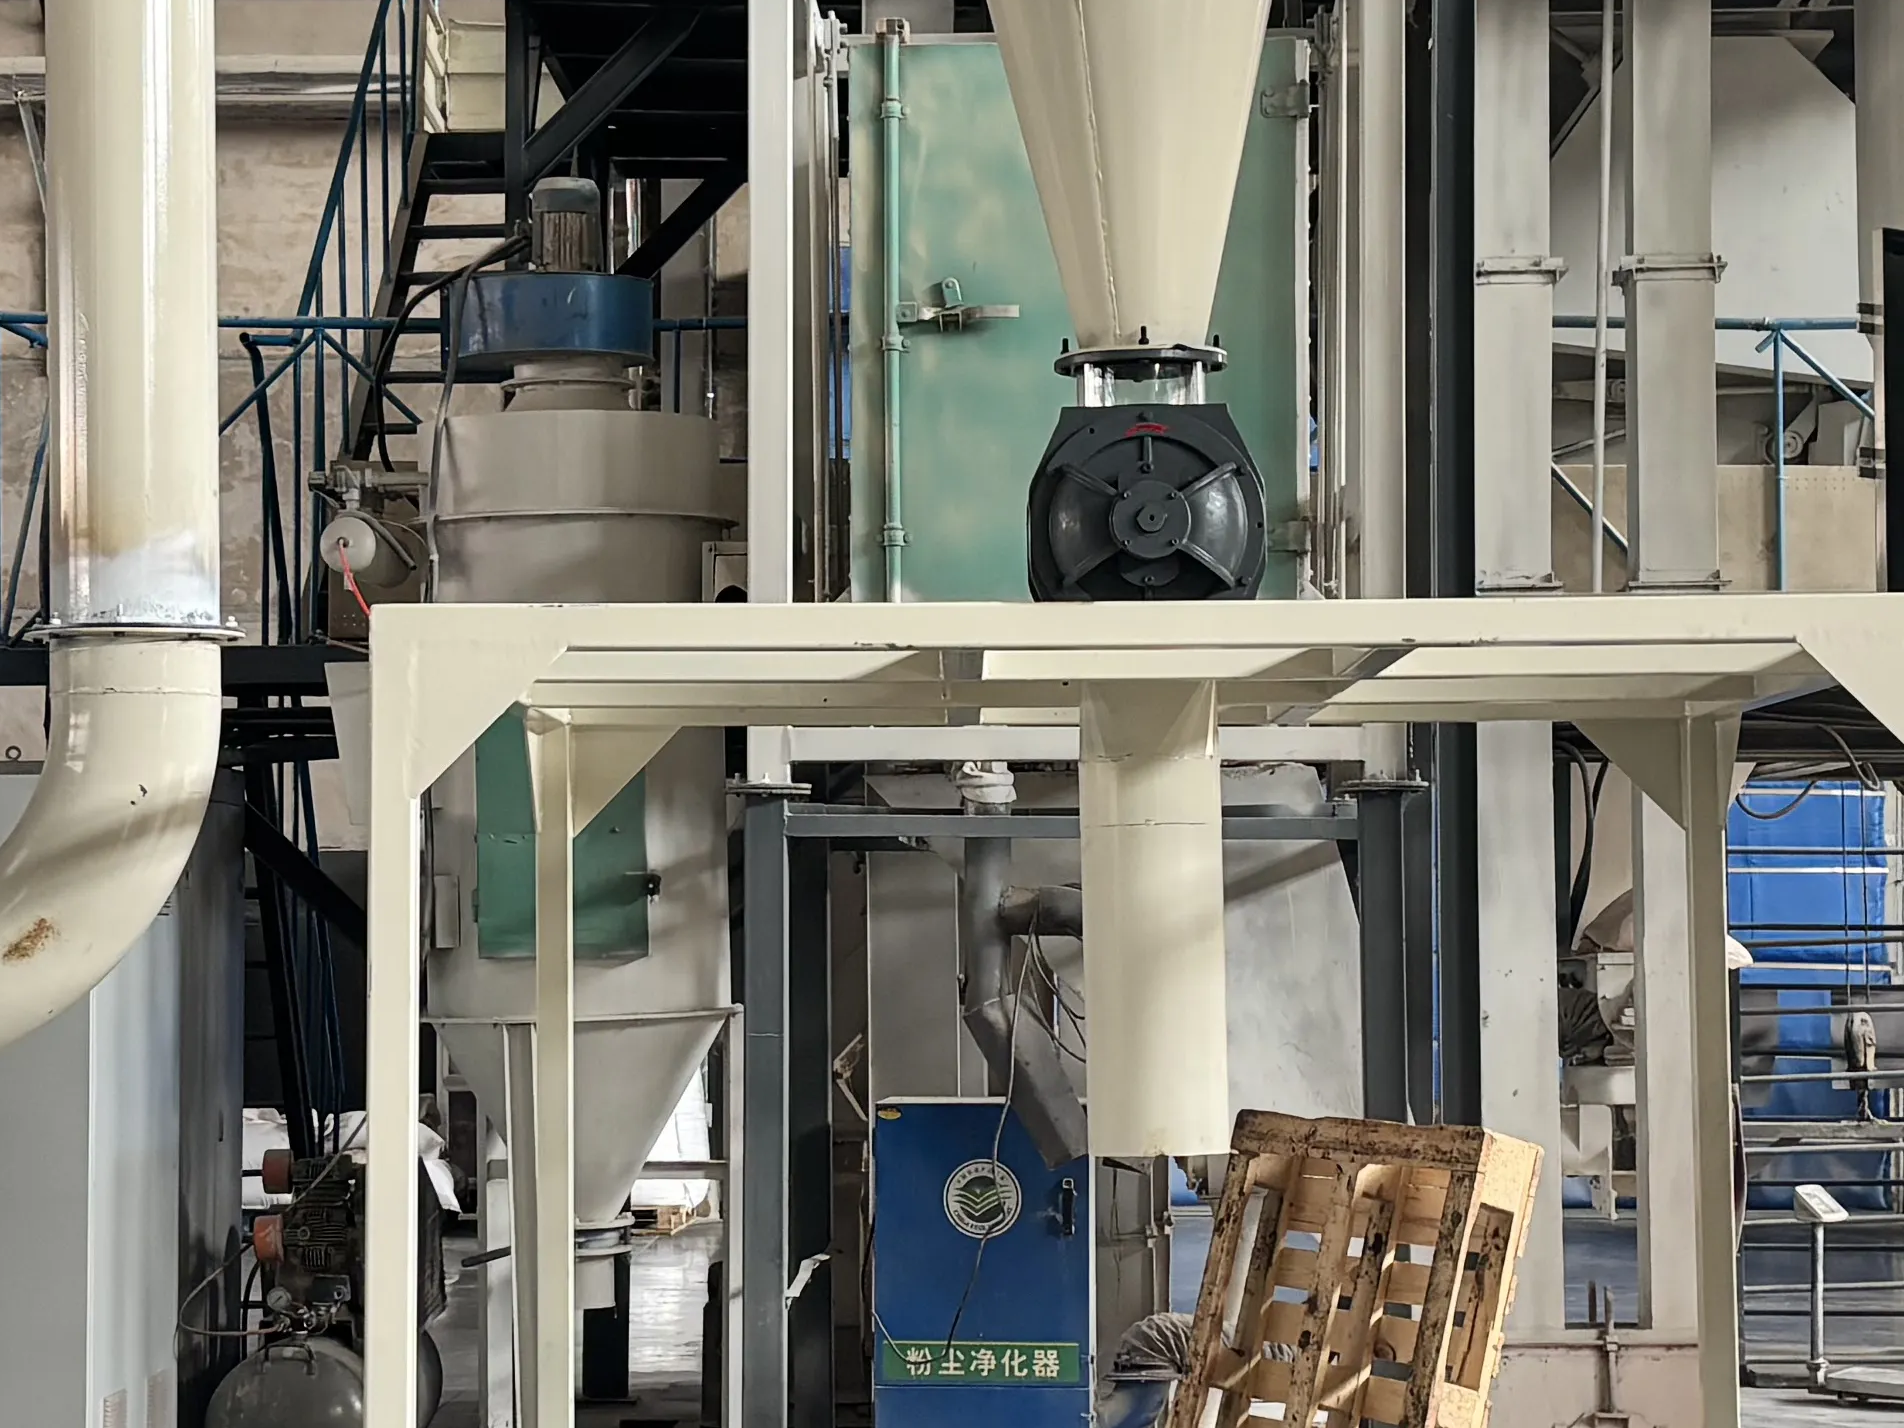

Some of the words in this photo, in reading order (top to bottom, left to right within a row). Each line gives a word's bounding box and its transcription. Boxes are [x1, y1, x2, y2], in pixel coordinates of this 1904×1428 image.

[905, 1347, 1061, 1378] 粉尘净化器
